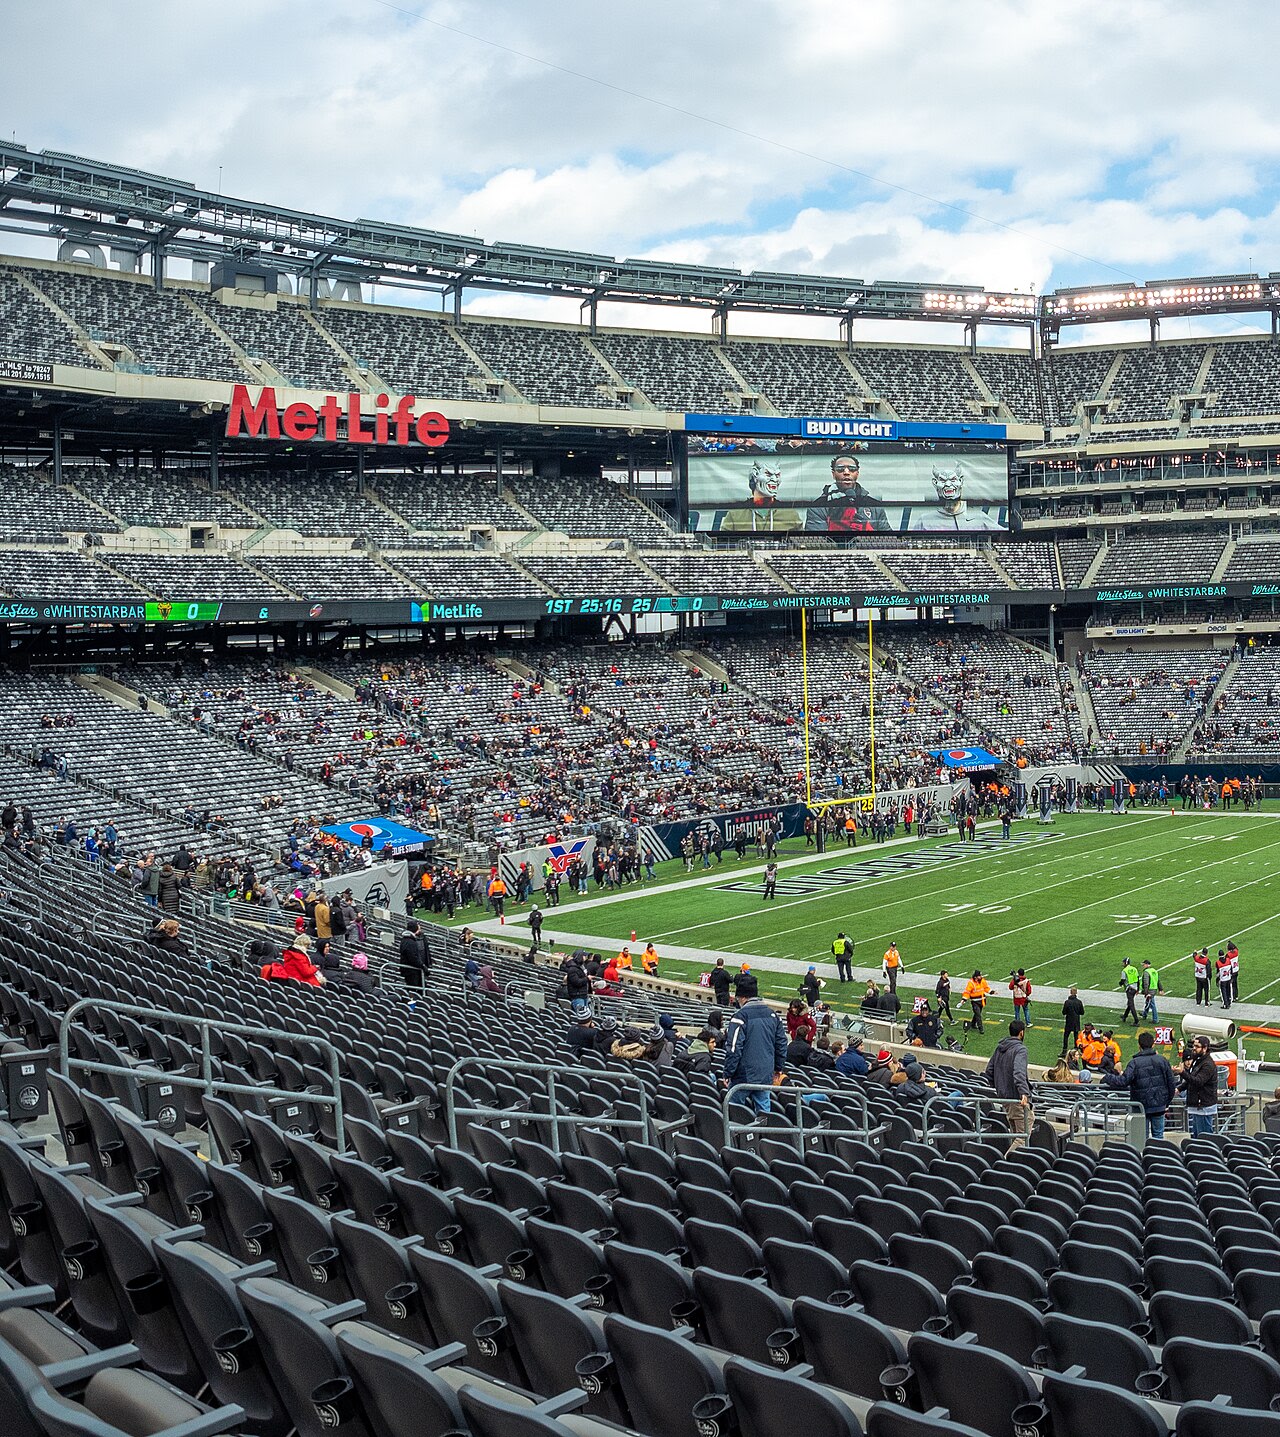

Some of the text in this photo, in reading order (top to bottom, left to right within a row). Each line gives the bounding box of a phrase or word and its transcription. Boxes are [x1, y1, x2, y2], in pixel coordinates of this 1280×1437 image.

[226, 384, 450, 447] MetLife
[807, 421, 893, 437] BUD LIGHT
[914, 594, 990, 605] @WHITESTARBAR
[1147, 586, 1226, 598] @WHITESTARBAR
[545, 598, 651, 613] 1ST 25:16 25
[773, 597, 850, 607] @WHITESTARBAR
[44, 603, 145, 619] @WHITESTARBAR
[259, 607, 268, 618] &
[433, 603, 483, 619] MetLife
[1208, 624, 1227, 633] pepsi
[862, 799, 874, 811] 25
[707, 829, 1065, 897] GUARDIANS
[1155, 1028, 1172, 1043] 30
